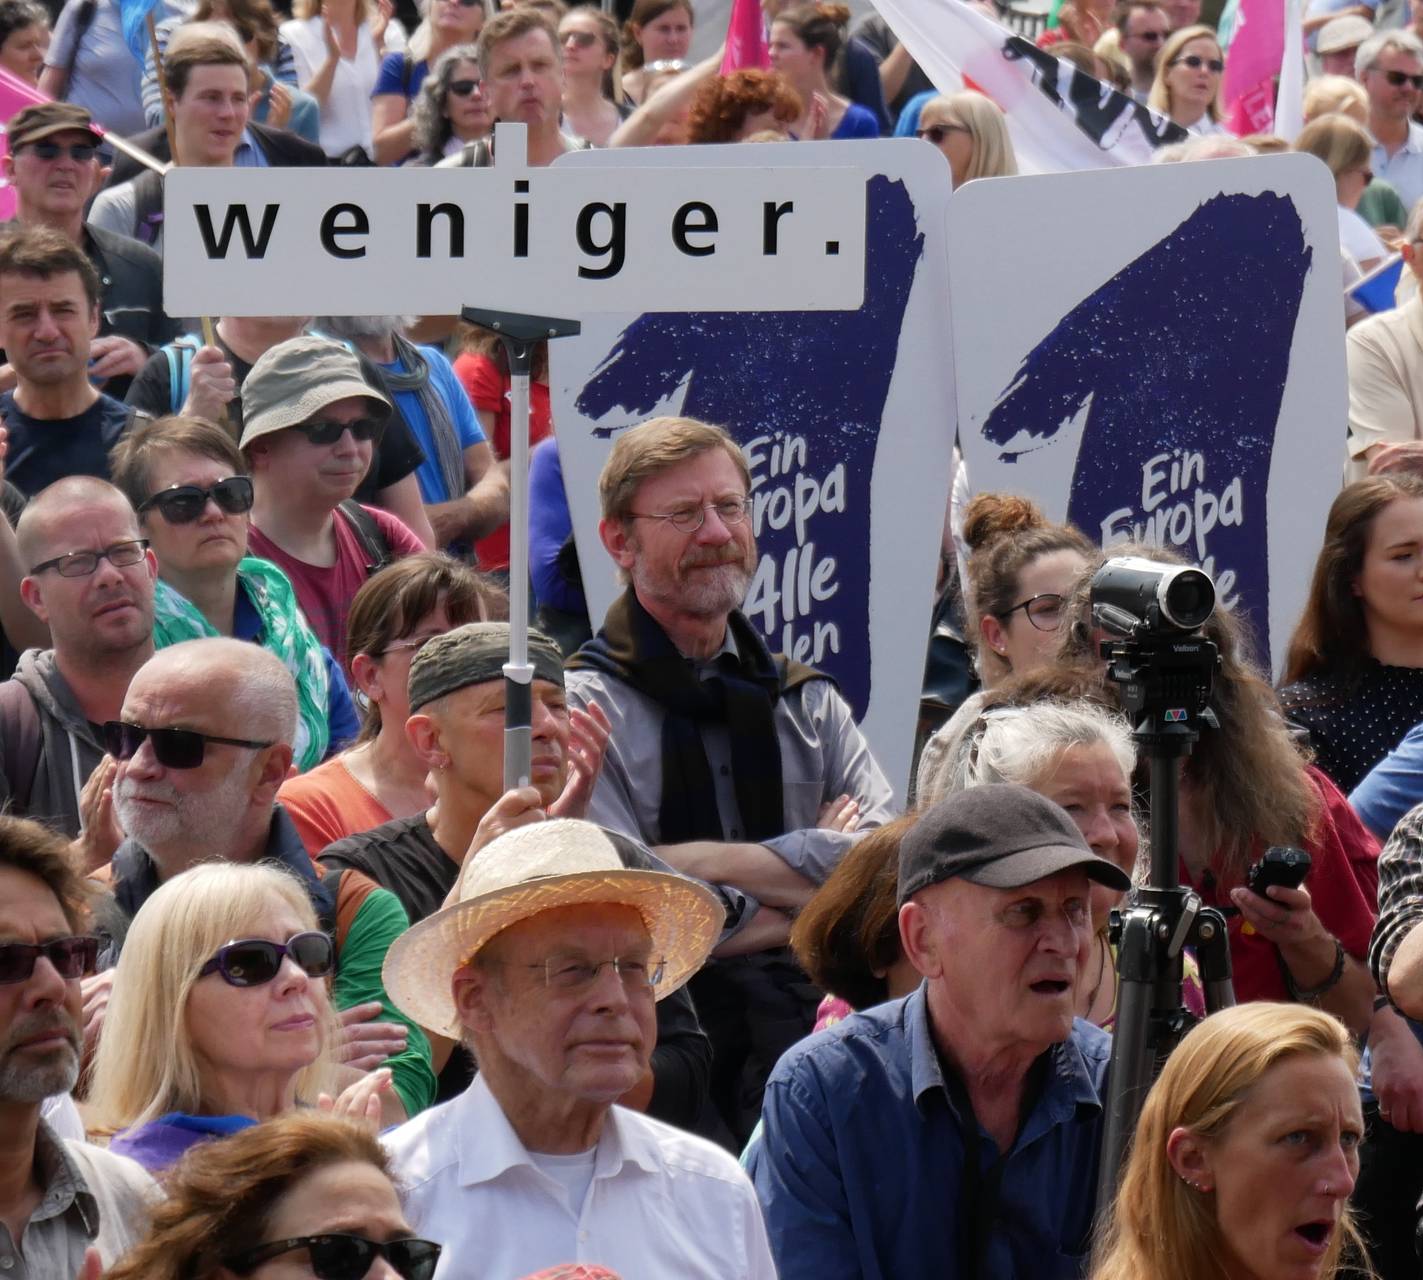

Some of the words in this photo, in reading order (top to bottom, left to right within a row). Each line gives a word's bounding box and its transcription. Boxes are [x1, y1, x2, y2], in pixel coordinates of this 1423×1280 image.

[193, 180, 840, 279] weniger.
[741, 431, 806, 492] Ein
[1141, 449, 1204, 512] Ein
[753, 463, 845, 547] ropa
[741, 542, 840, 635] Alle
